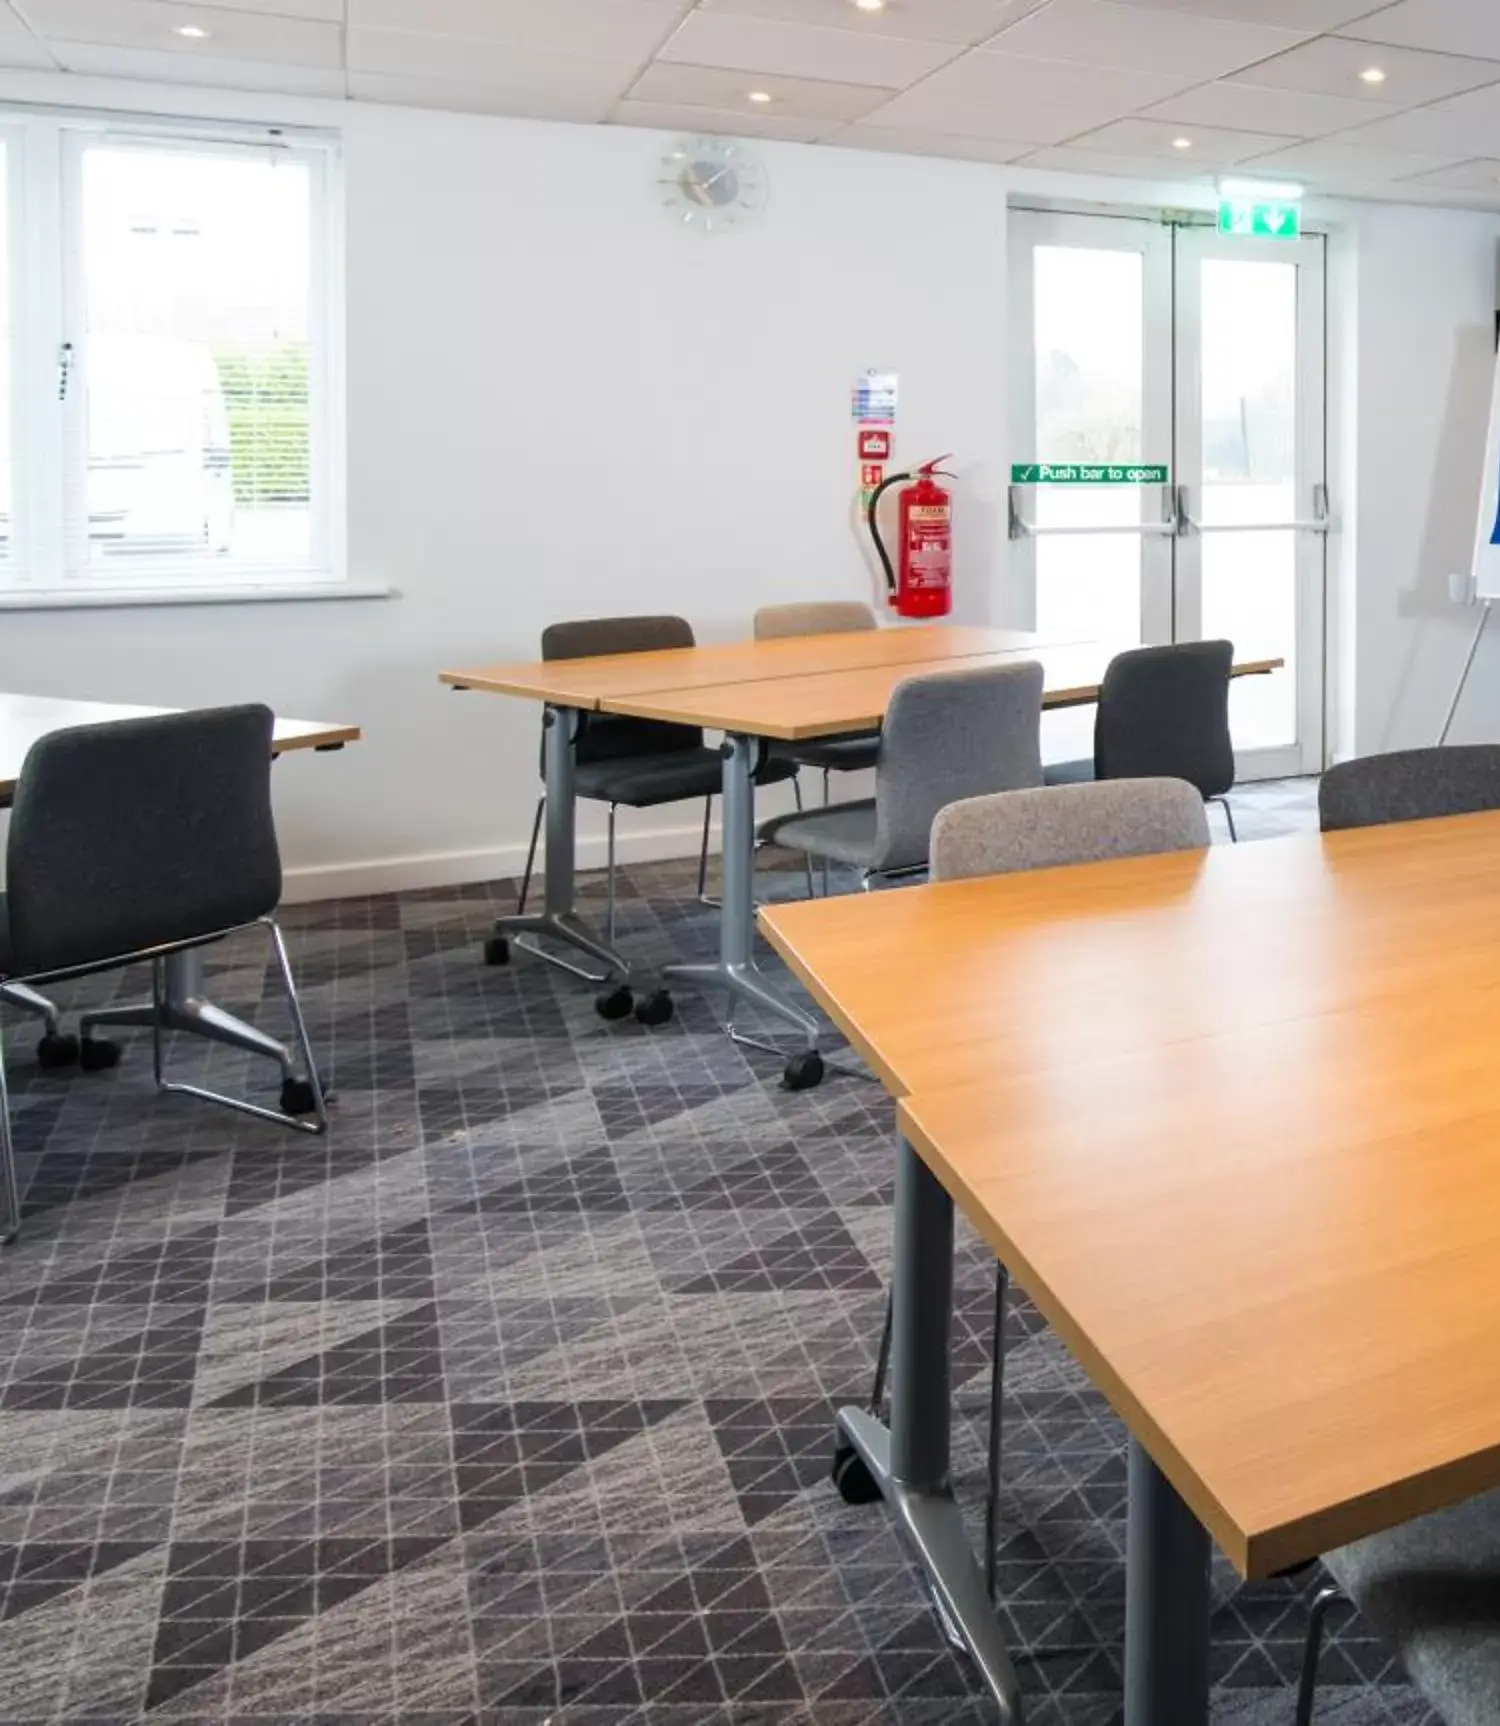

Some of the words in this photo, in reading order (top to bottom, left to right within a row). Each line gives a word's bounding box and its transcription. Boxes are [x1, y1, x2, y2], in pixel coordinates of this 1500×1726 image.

[1039, 465, 1076, 480] Push
[1080, 465, 1104, 480] bar
[1108, 467, 1122, 480] to
[1126, 467, 1161, 484] open
